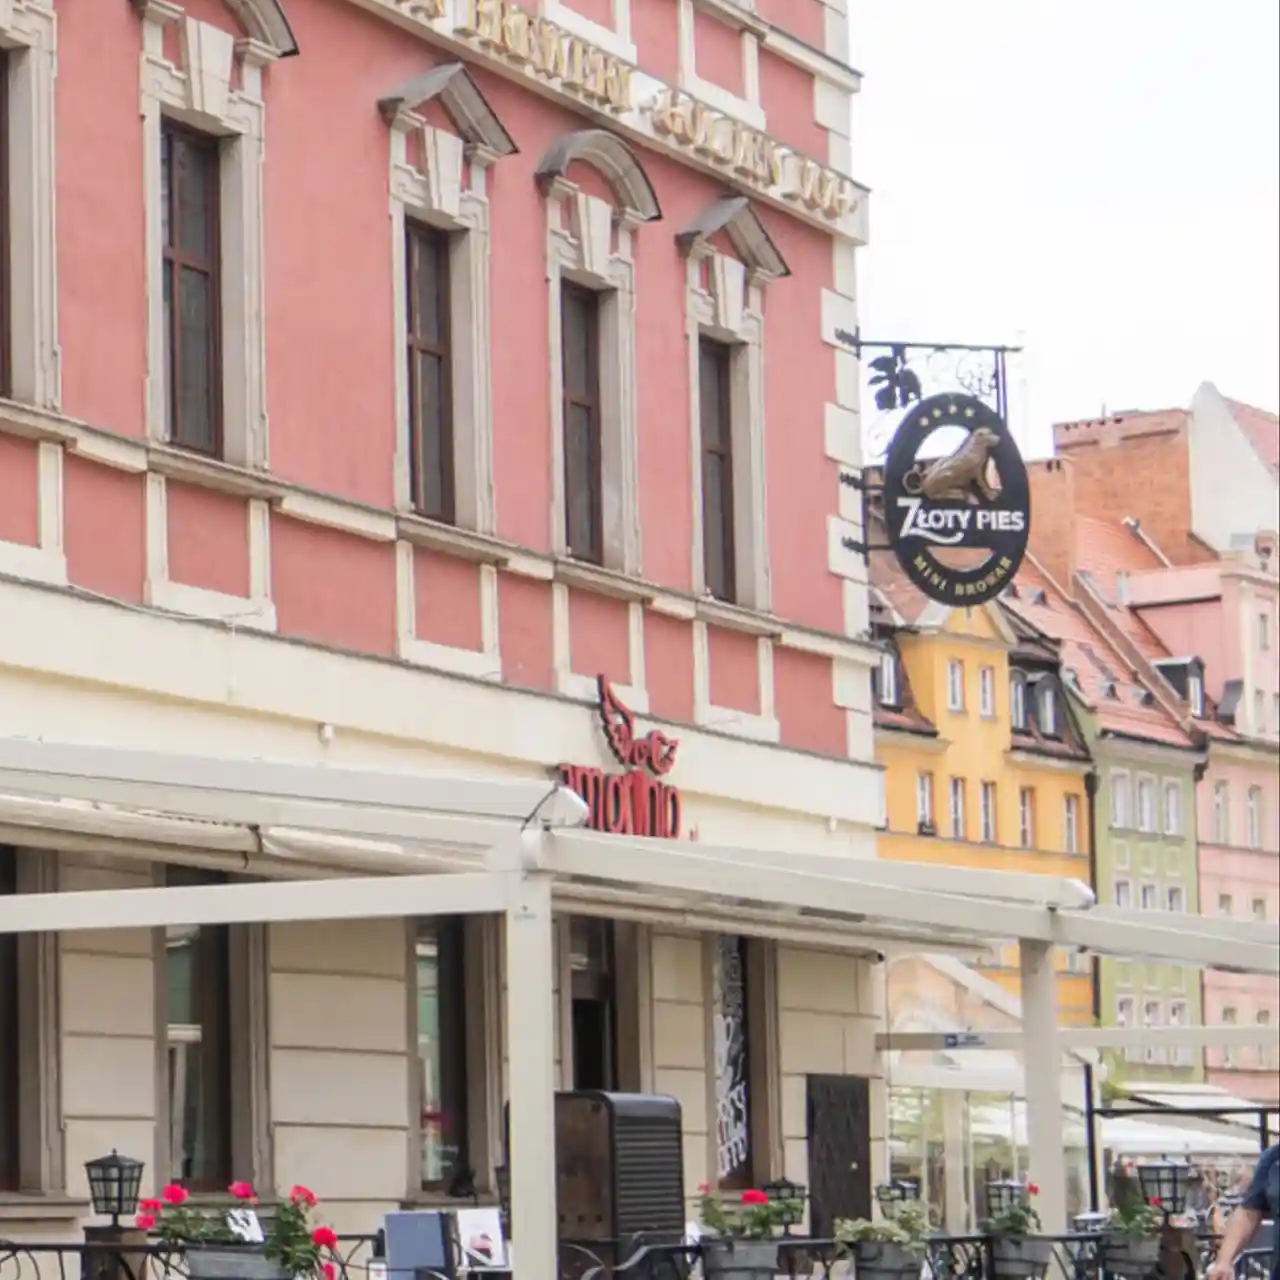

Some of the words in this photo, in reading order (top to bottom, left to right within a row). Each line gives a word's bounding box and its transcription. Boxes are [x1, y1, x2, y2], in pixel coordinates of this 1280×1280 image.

[896, 496, 972, 544] ZŁOTY
[976, 509, 1025, 532] PIES
[912, 553, 948, 591] MINI
[953, 555, 1013, 596] BROWAR
